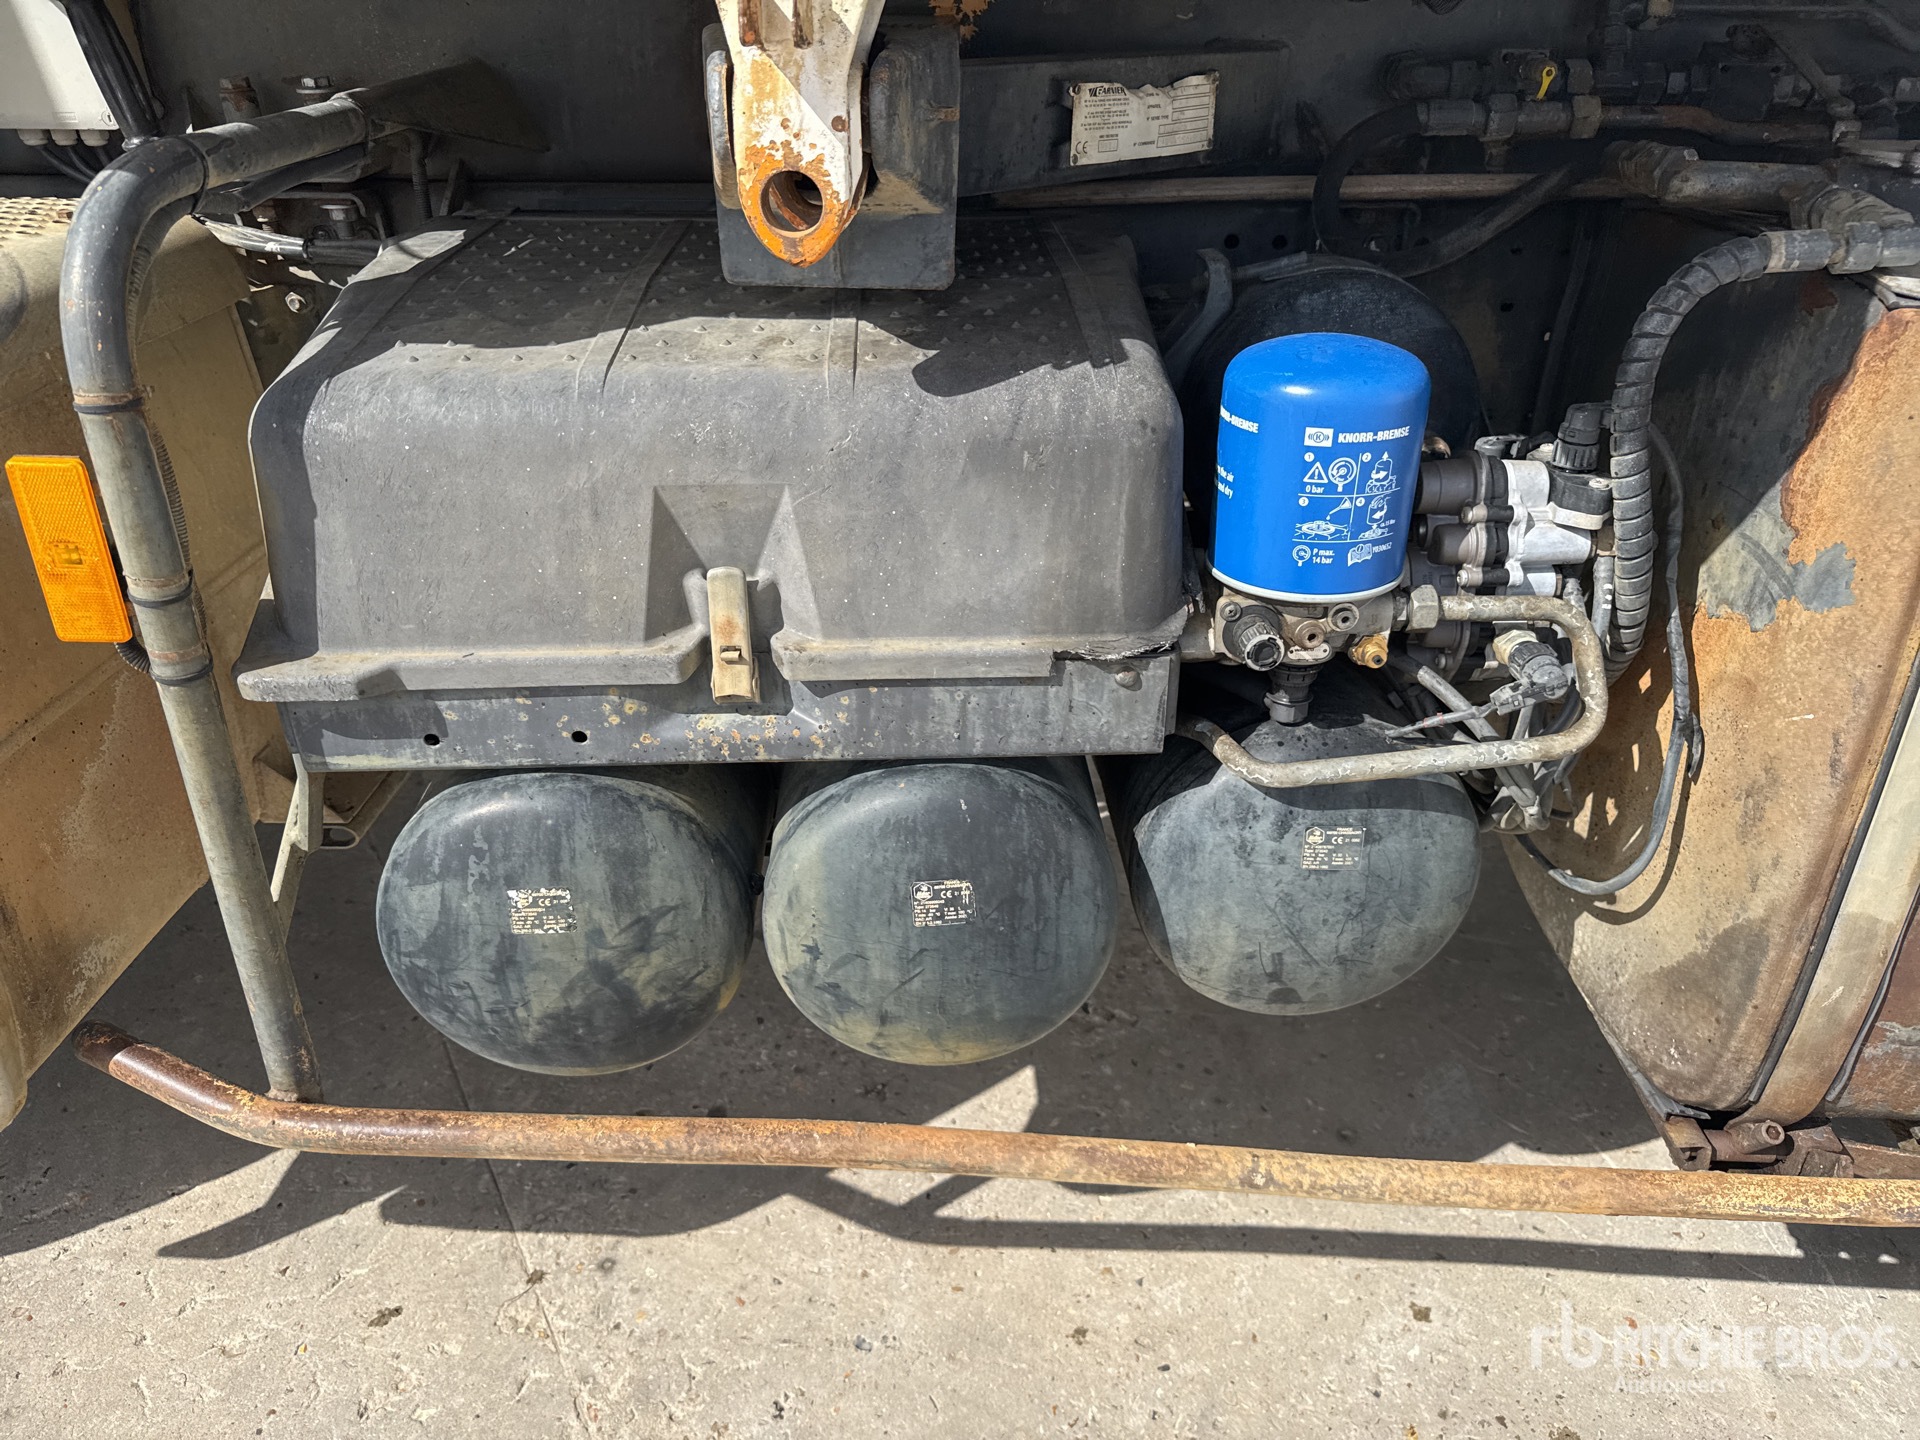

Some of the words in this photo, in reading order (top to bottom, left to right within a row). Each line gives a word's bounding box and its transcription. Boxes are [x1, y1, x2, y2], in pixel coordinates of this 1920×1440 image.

[1338, 426, 1410, 443] KNORR-BREMSE
[1311, 485, 1325, 493] bar
[1331, 836, 1344, 844] CE
[940, 890, 953, 899] CE
[538, 898, 552, 907] CE
